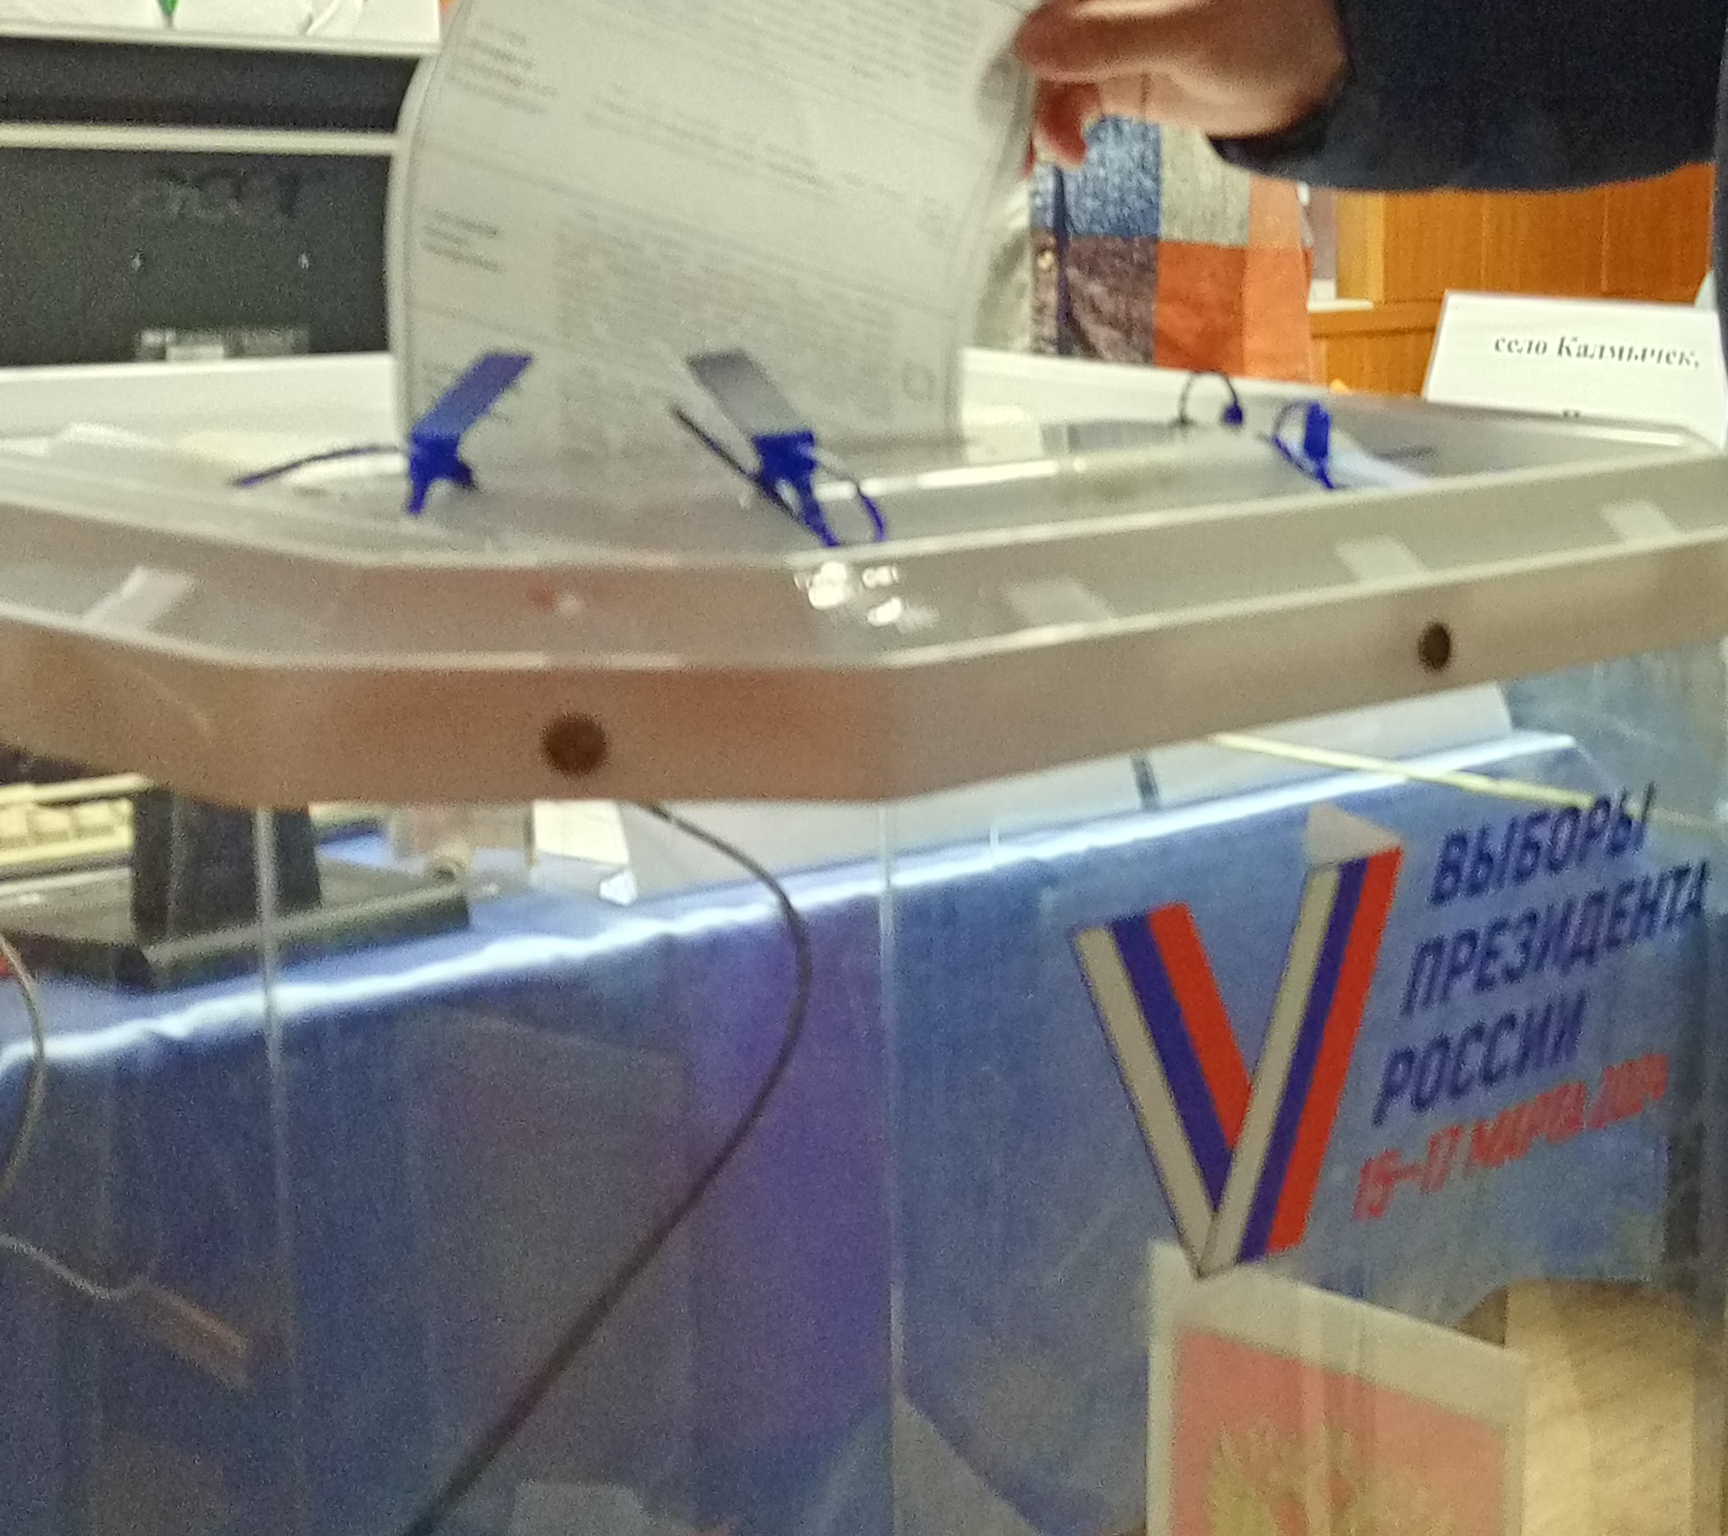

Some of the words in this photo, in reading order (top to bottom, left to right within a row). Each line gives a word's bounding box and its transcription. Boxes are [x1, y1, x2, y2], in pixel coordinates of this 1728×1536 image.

[1494, 336, 1548, 356] село
[1557, 335, 1700, 369] Калмычек,
[1427, 781, 1658, 907] ВЫБОРЫ
[1401, 859, 1712, 1017] ПРЕЗИДЕНТА
[1372, 987, 1588, 1128] РОССИИ
